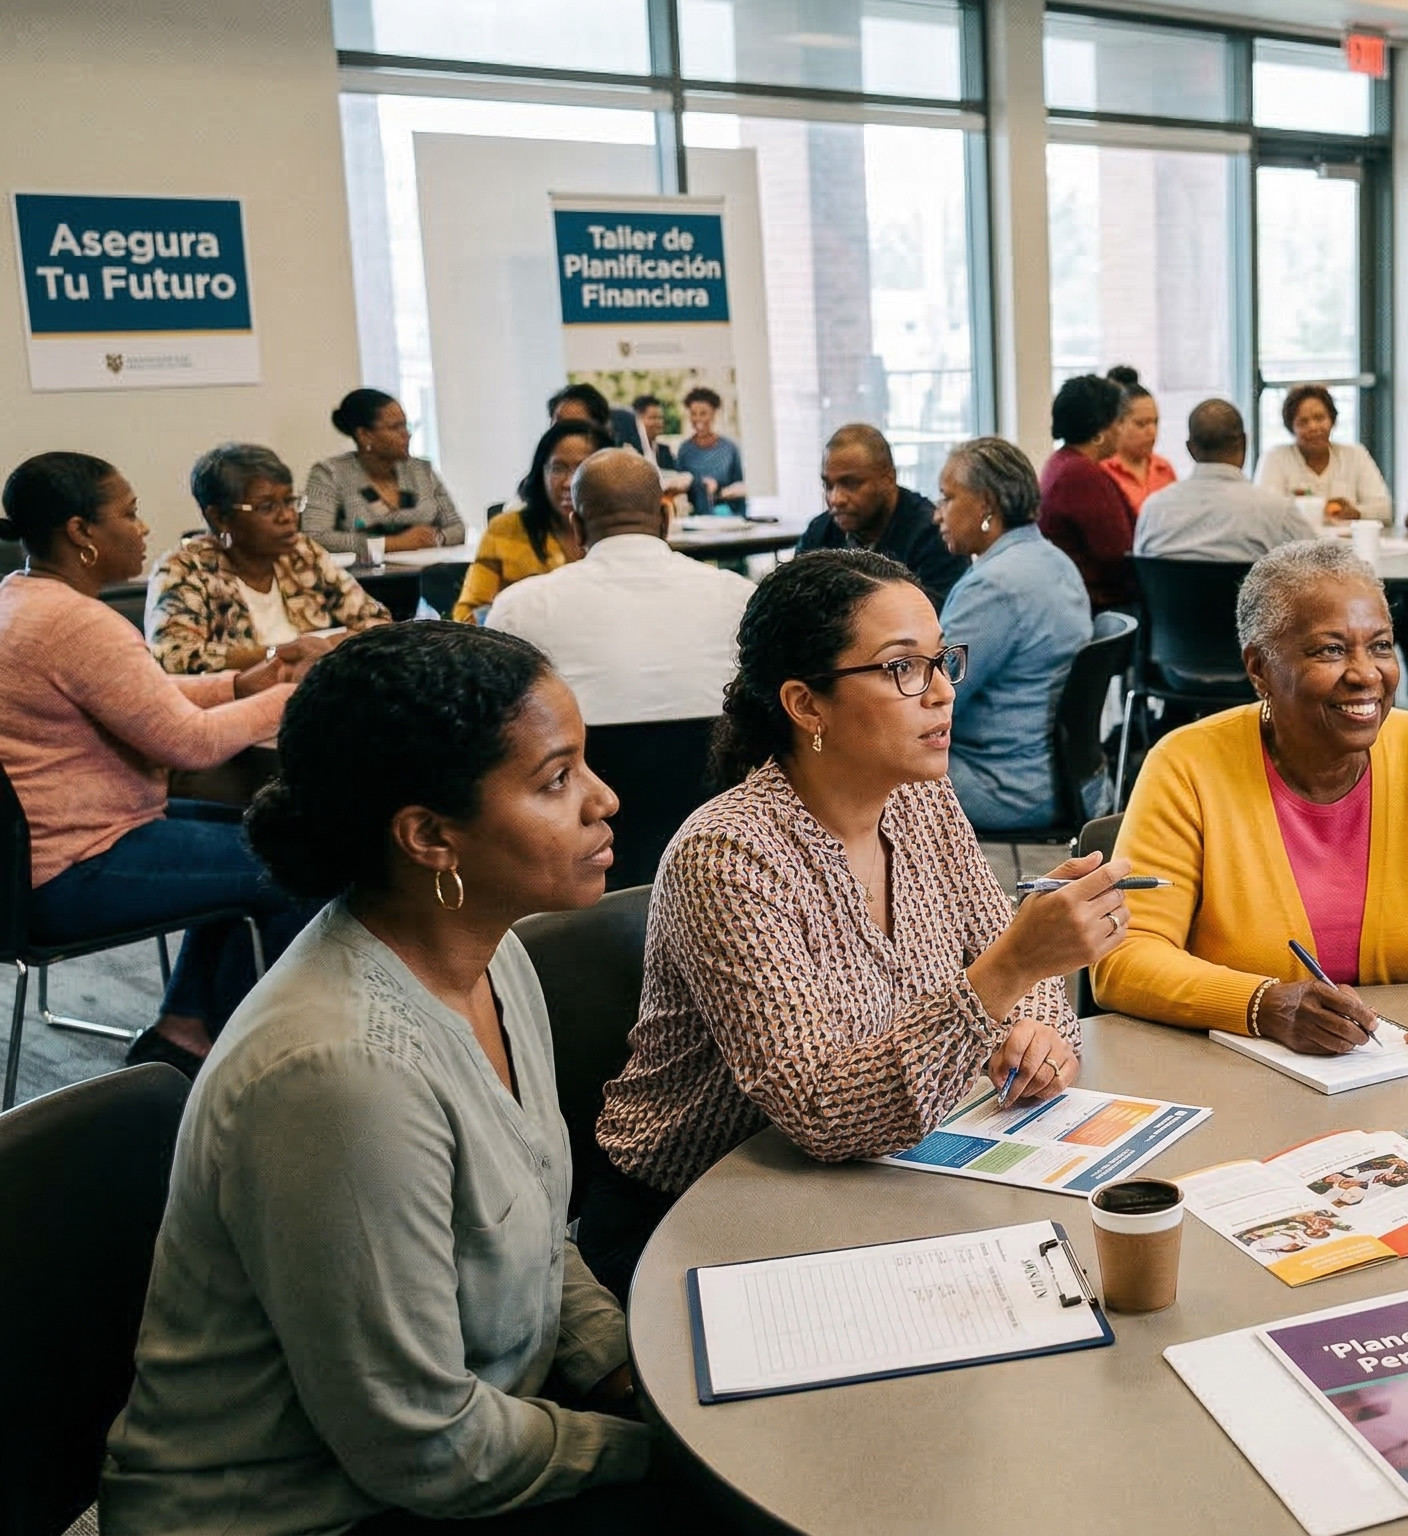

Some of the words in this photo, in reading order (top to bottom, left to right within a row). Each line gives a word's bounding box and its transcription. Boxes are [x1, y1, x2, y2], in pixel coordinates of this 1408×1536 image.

[50, 223, 220, 264] Asegura
[588, 225, 657, 251] Taller
[662, 227, 694, 251] de
[564, 253, 722, 279] Planificación
[36, 266, 89, 300] Tu
[102, 266, 237, 300] Futuro
[582, 283, 710, 308] Financiera
